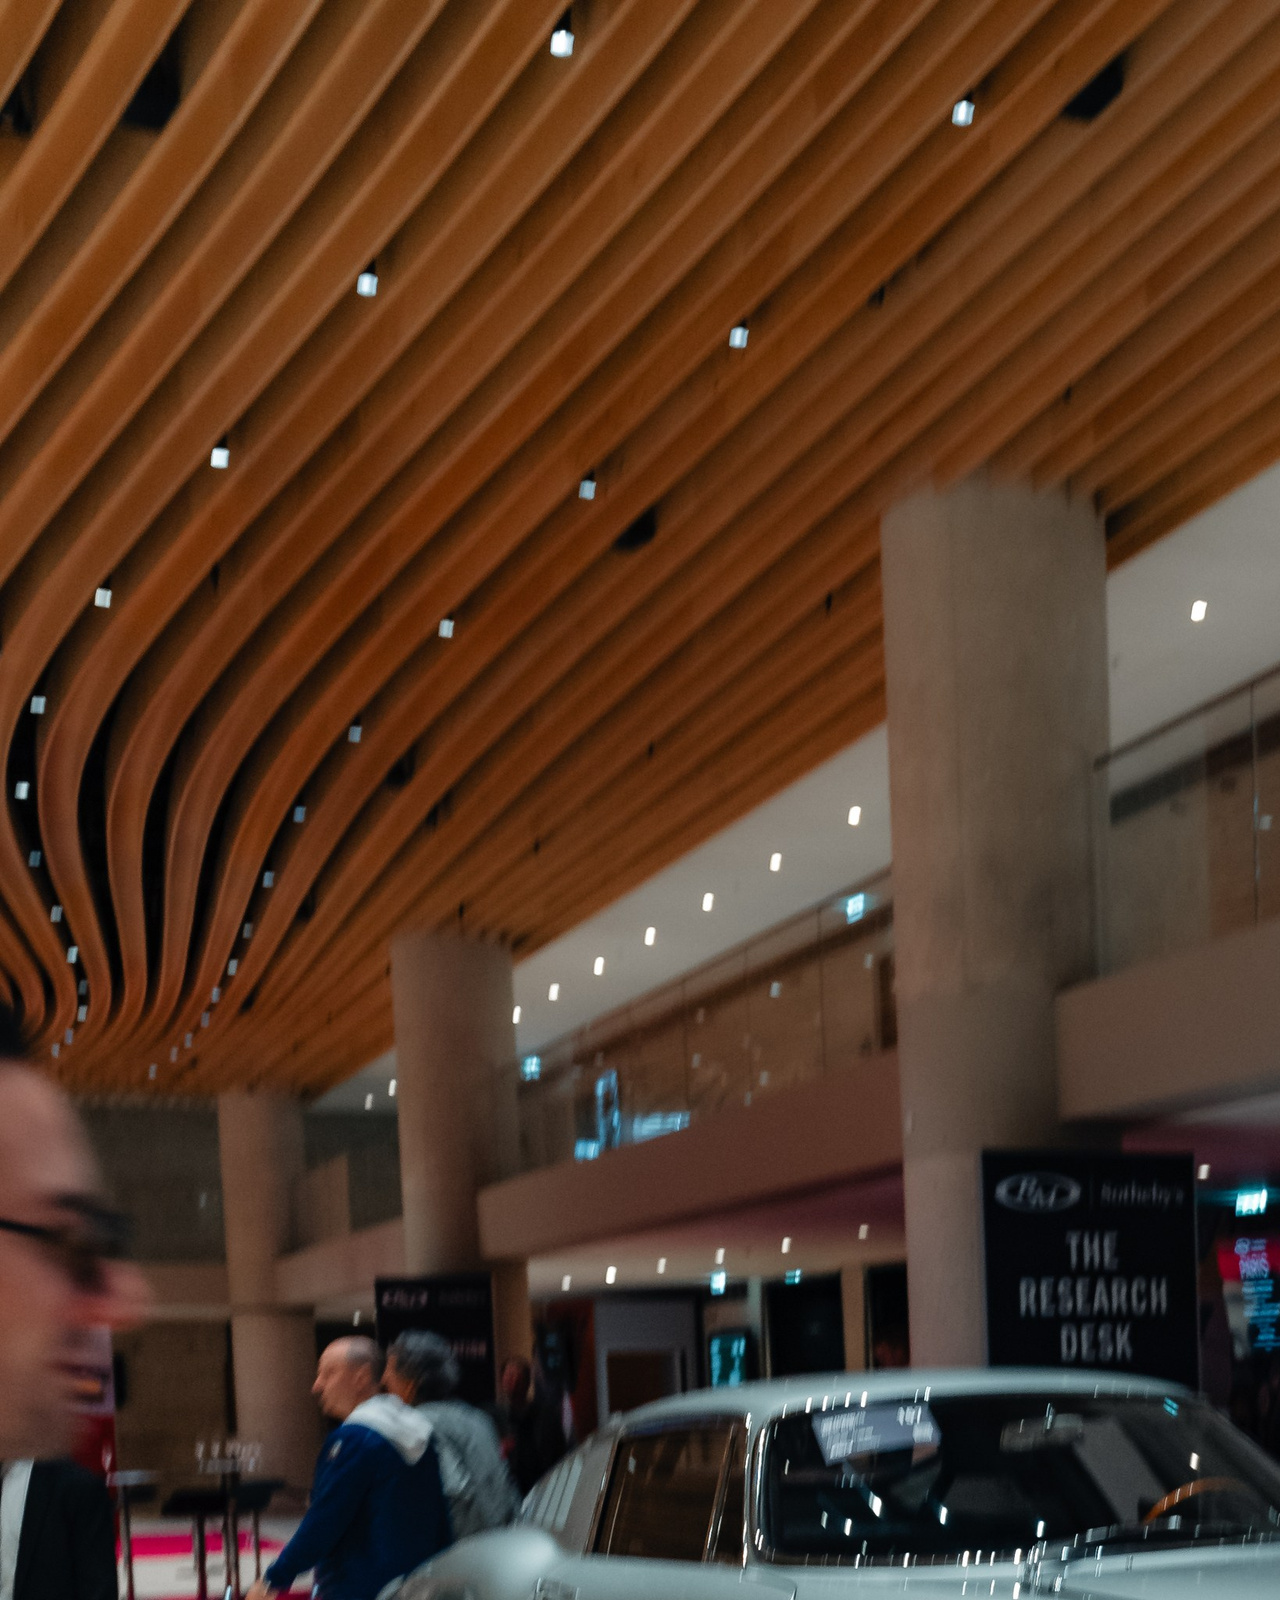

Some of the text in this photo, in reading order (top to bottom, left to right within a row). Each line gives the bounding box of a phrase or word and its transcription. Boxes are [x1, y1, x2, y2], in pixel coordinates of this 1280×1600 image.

[1065, 1230, 1119, 1271] THE
[1018, 1276, 1168, 1319] RESEARCH
[1060, 1323, 1132, 1363] DESK
